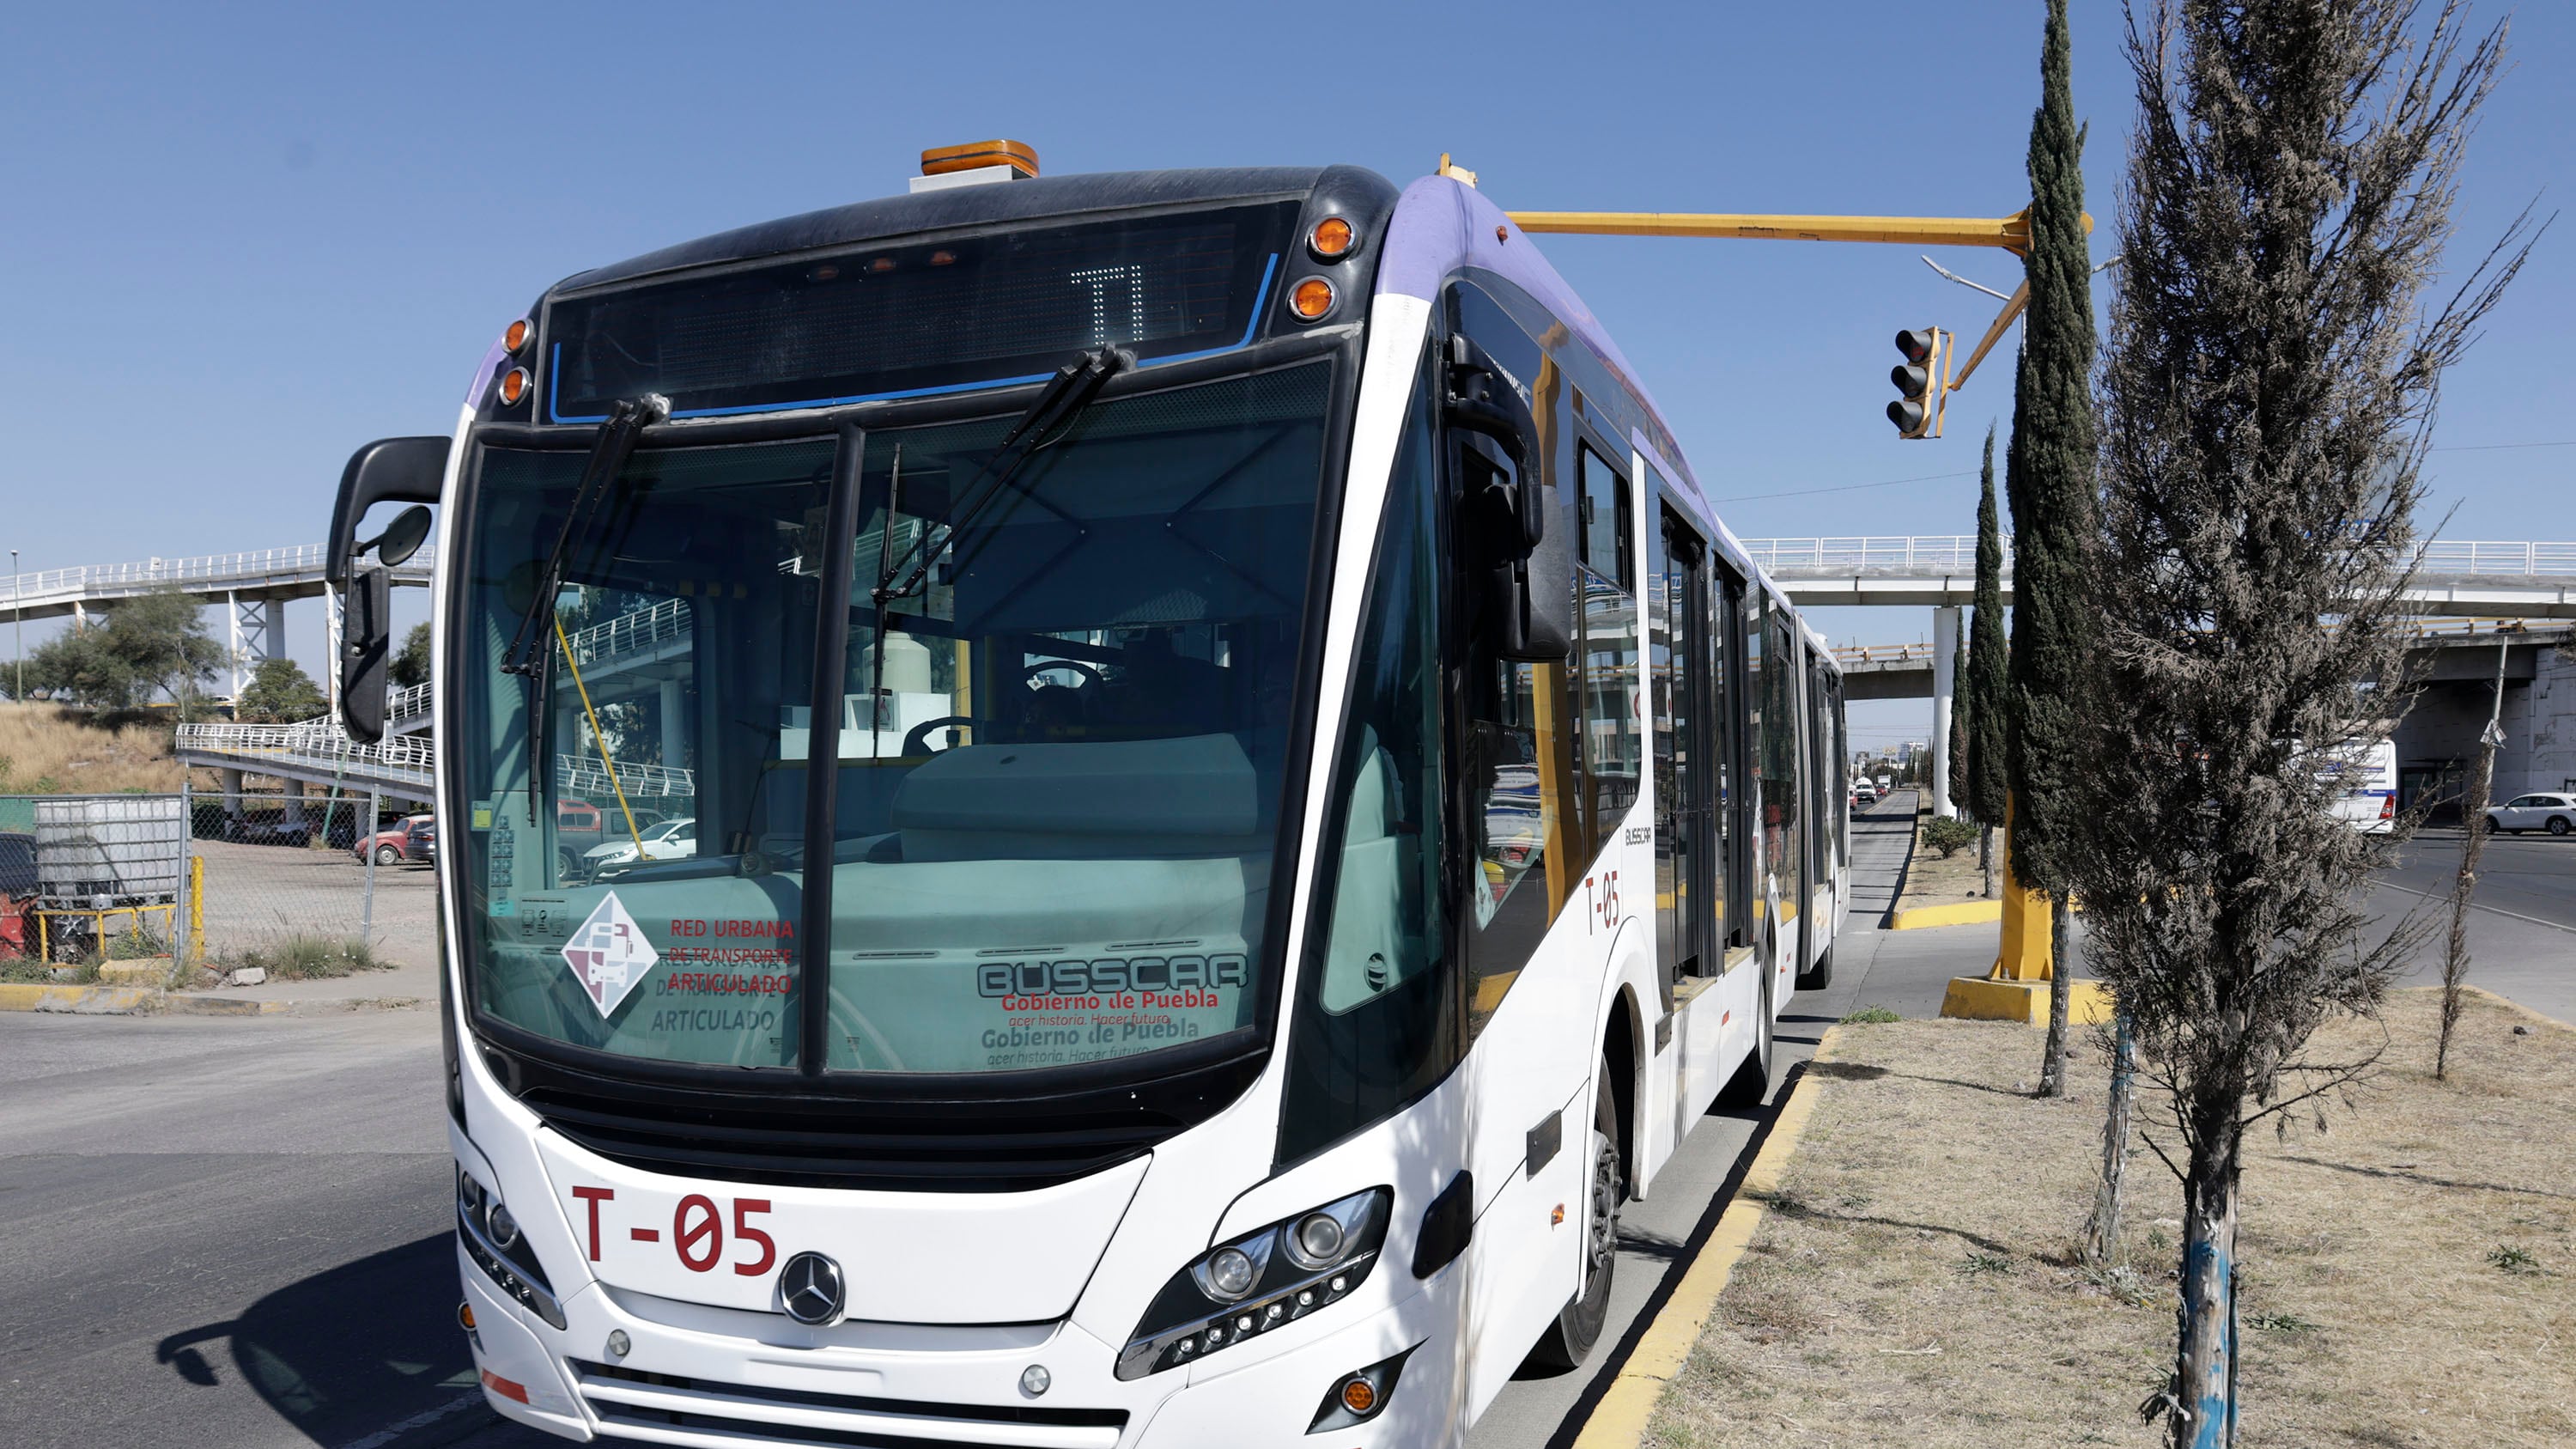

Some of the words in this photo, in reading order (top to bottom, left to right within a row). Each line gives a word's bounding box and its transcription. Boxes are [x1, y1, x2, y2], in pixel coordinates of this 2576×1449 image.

[1625, 827, 1651, 846] BUSSCAR
[1586, 870, 1619, 935] T-05
[671, 920, 707, 936] RED
[714, 921, 794, 938] URBANA
[669, 947, 688, 961] DE
[692, 947, 793, 964] TRANSPORTE
[666, 972, 793, 994] ARTICULADO
[977, 953, 1249, 997] BUSSCAR
[1002, 991, 1100, 1011] Gobierno
[1109, 990, 1134, 1009] de
[1141, 989, 1218, 1008] Puebla
[652, 1010, 775, 1031] ARTICULADO
[1091, 1014, 1129, 1026] Hacer
[981, 1026, 1080, 1048] Gobierno
[1122, 1018, 1199, 1042] Puebla
[573, 1185, 776, 1276] T-05
